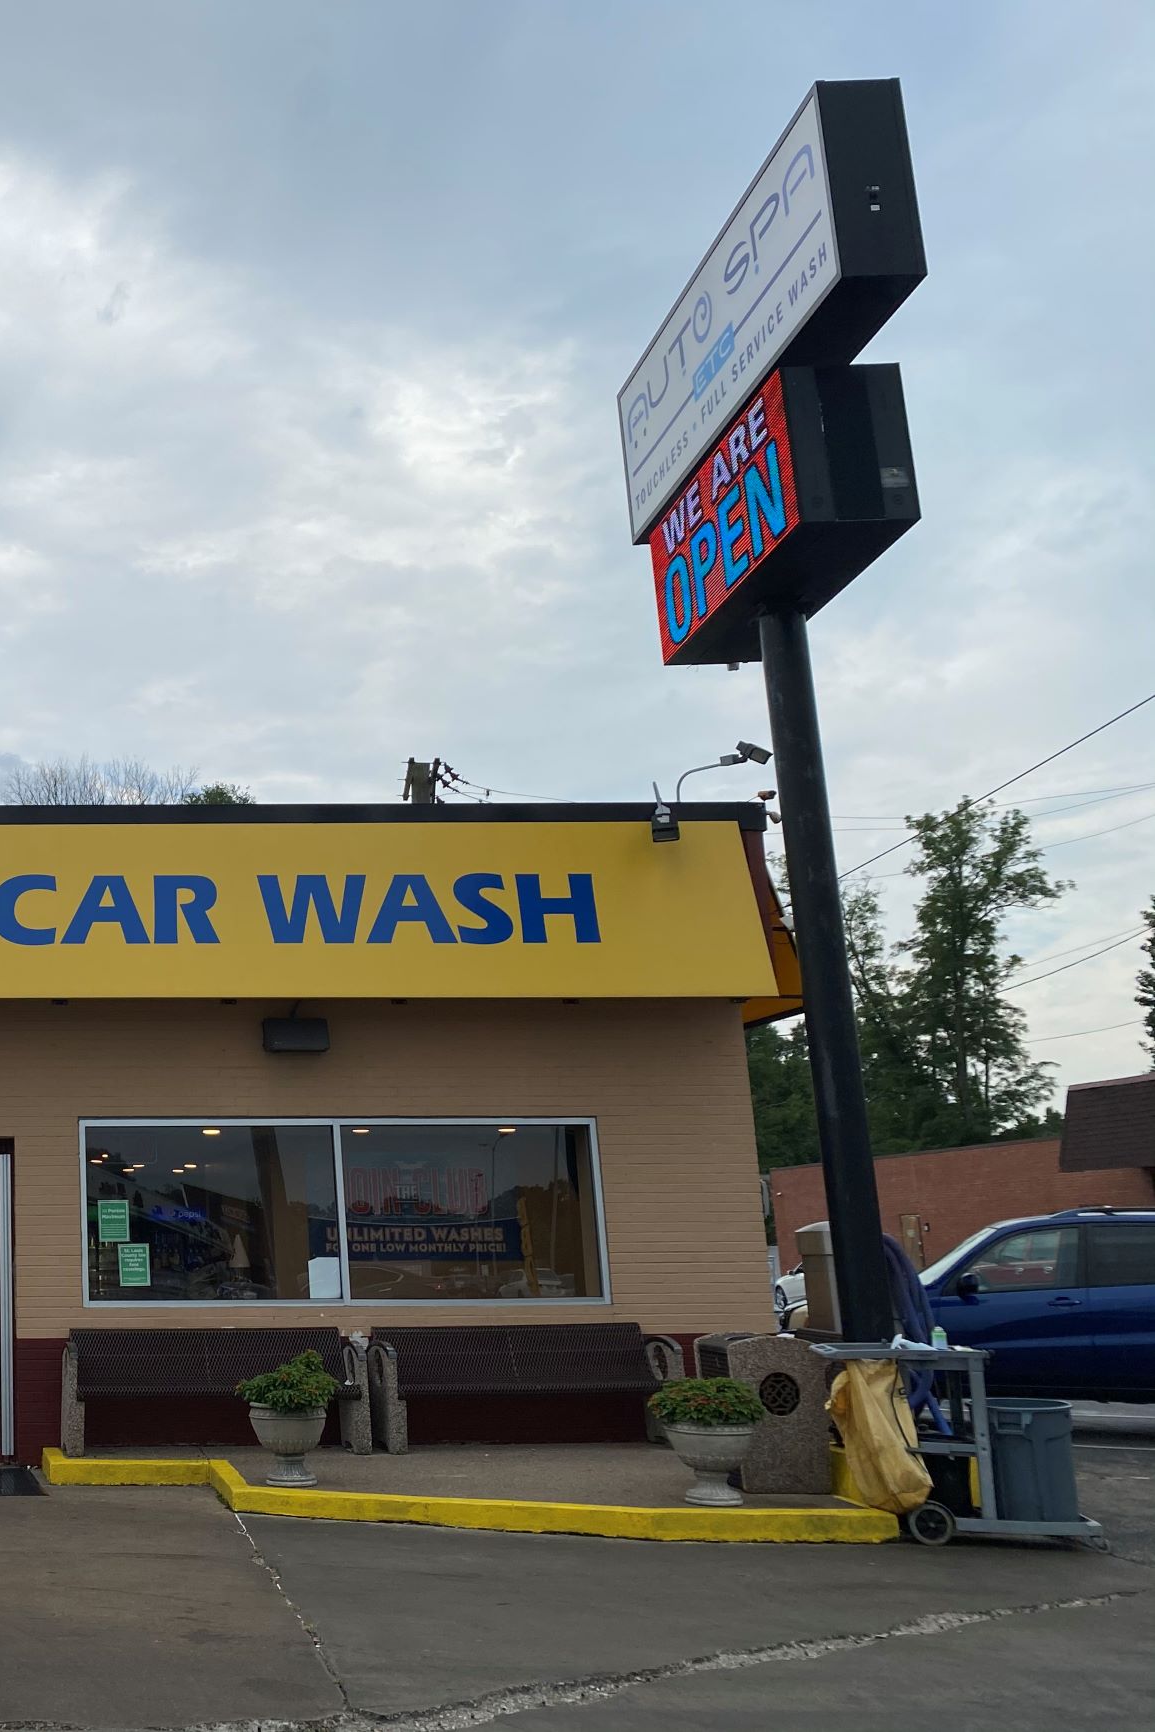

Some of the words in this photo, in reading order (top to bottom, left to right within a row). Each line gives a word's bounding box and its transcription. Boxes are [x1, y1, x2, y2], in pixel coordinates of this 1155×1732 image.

[627, 291, 713, 447] AUTO
[723, 143, 815, 295] SPA
[634, 430, 689, 512] TOUCHLESS
[700, 380, 727, 425] FULL
[730, 302, 785, 384] SERVICE
[787, 242, 828, 308] WASH
[695, 334, 734, 392] ETC
[661, 480, 703, 555] WE
[710, 397, 769, 501] ARE
[663, 439, 788, 646] OPEN
[256, 872, 603, 945] WASH
[345, 1167, 402, 1215] OIN
[396, 1184, 419, 1200] THE
[412, 1167, 489, 1216] CLUB
[354, 1243, 377, 1252] ONE
[379, 1243, 406, 1252] LOW
[409, 1243, 467, 1252] MONTHLY
[469, 1243, 507, 1253] PRICE!
[430, 1227, 504, 1242] WASHES
